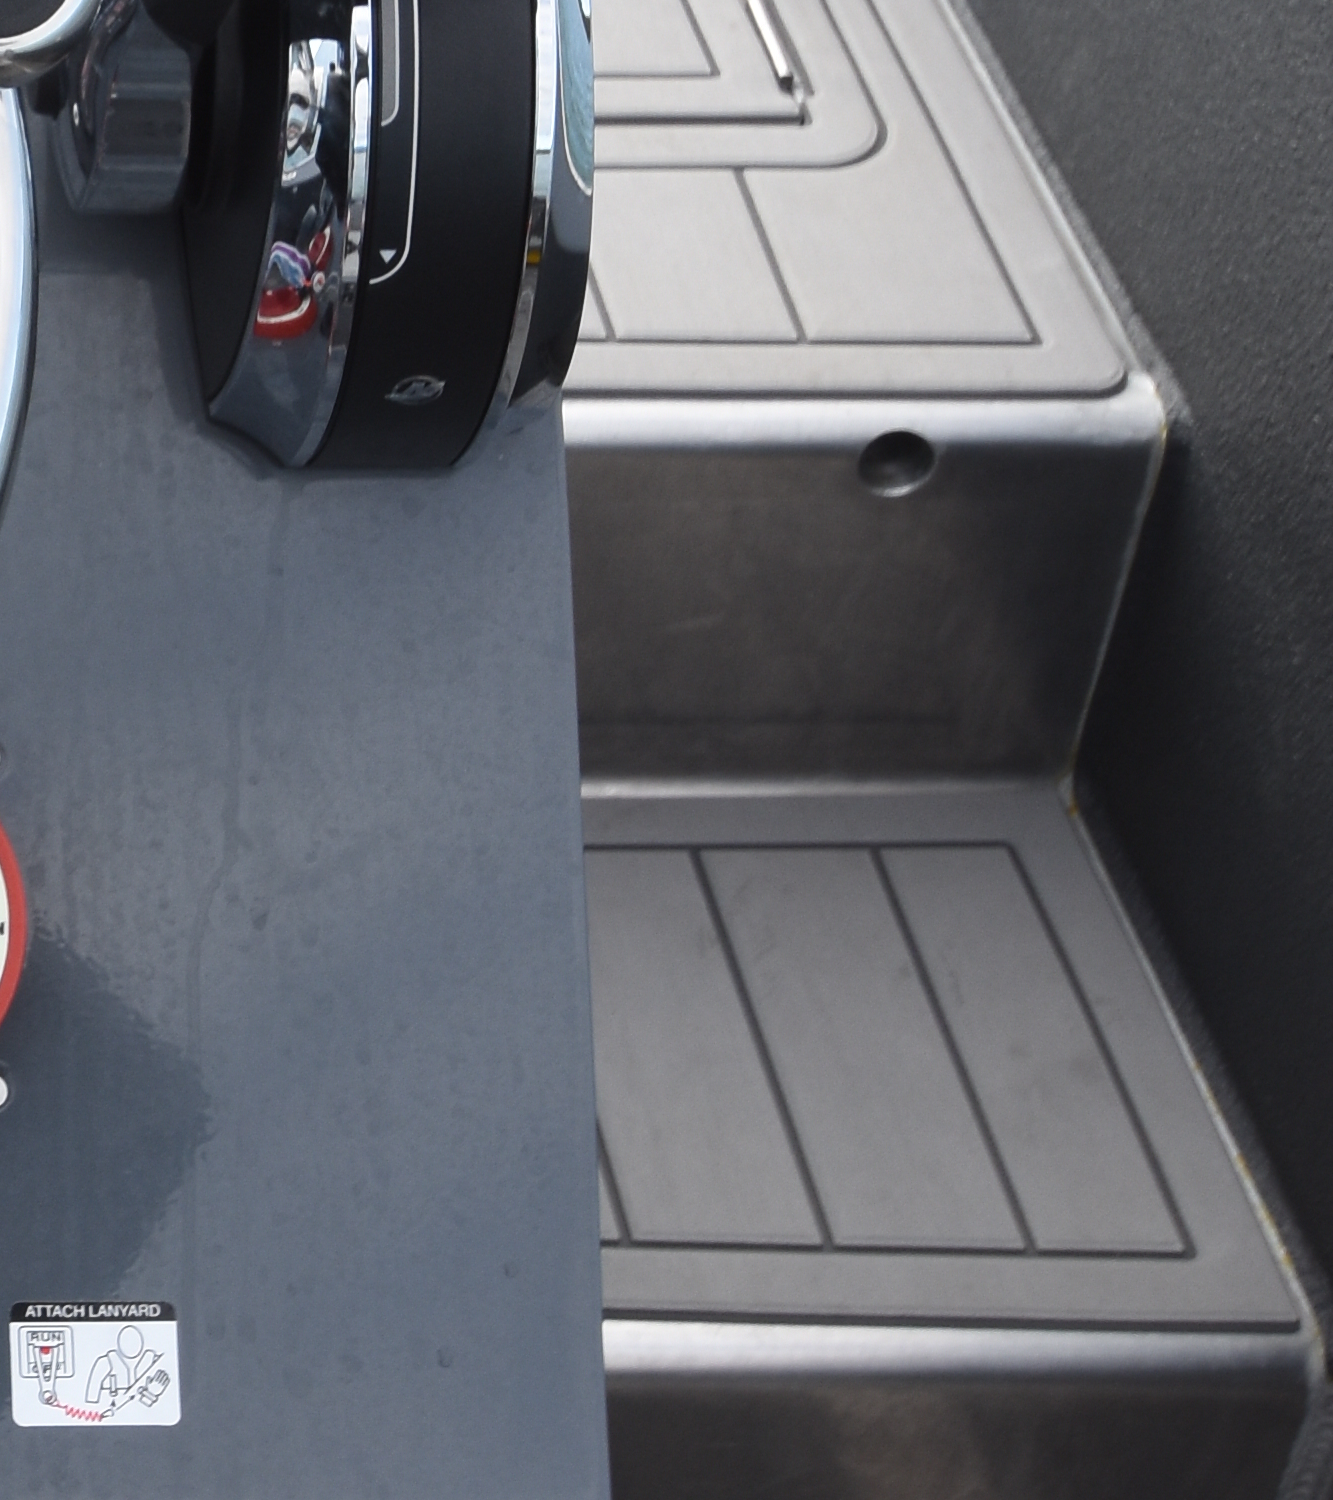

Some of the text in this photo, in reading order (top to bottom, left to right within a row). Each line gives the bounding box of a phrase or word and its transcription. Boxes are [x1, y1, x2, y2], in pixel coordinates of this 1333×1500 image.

[24, 1303, 161, 1318] ATTACH LANYARD
[30, 1332, 61, 1342] RUN
